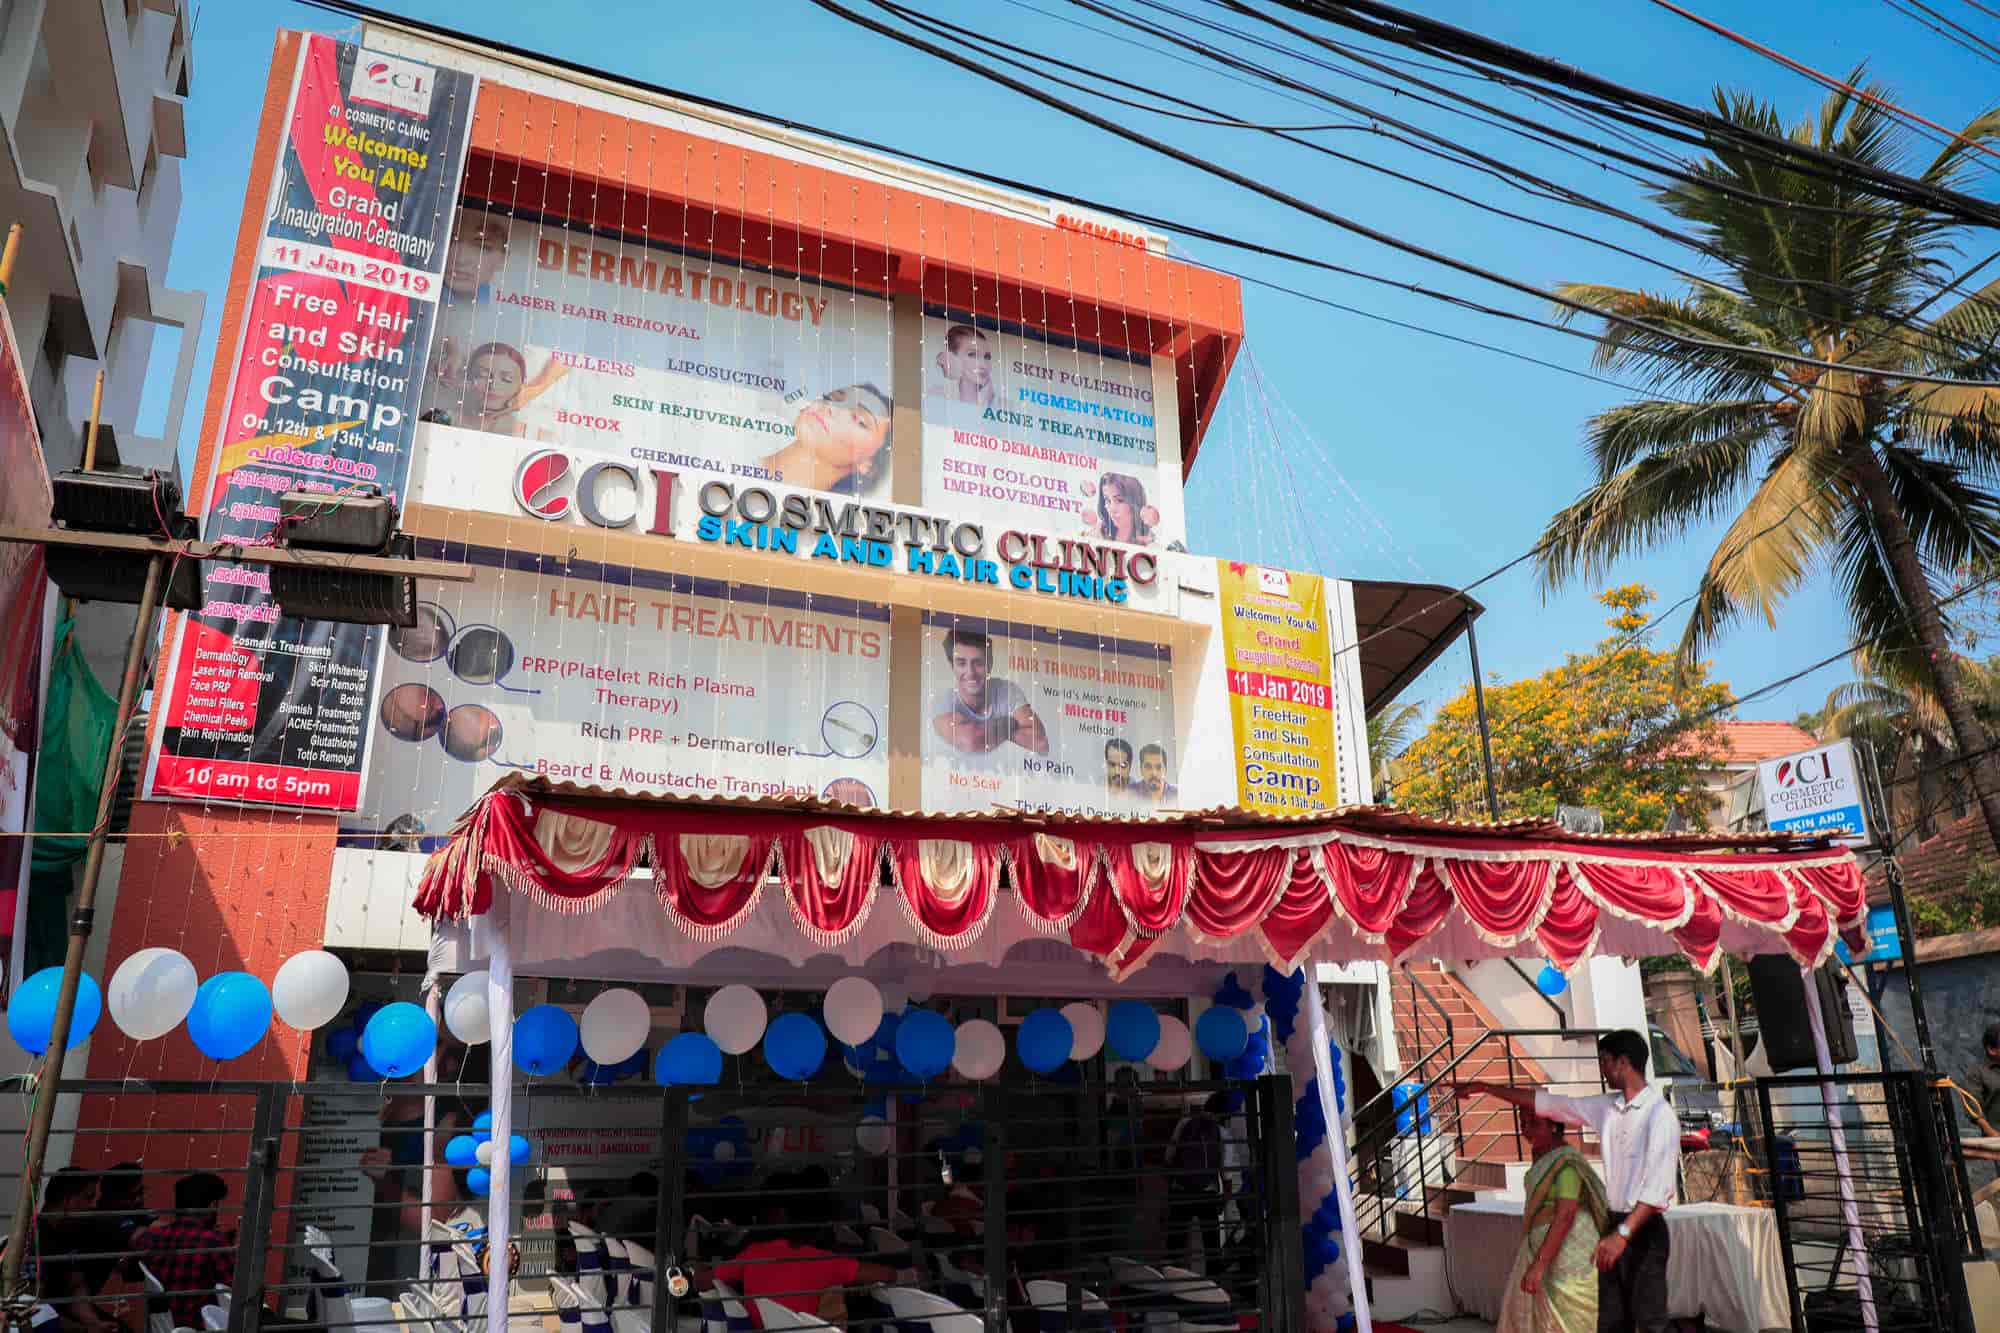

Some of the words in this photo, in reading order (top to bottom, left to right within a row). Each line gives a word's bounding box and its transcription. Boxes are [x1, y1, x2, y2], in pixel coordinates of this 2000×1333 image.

[345, 108, 396, 131] COSMETIC
[398, 121, 431, 141] CLINIC
[323, 124, 429, 169] Welcomes
[333, 155, 373, 184] You
[380, 167, 411, 193] All
[328, 187, 398, 221] Grand
[281, 201, 362, 240] Inaugration
[366, 218, 435, 264] Ceramany
[276, 246, 300, 264] 11
[310, 253, 355, 275] Jan
[364, 262, 430, 294] 2019
[538, 238, 829, 327] DERMATOLOGY
[273, 284, 338, 316] Free
[356, 302, 413, 333] Hair
[496, 289, 556, 313] LASER
[561, 303, 608, 323] HAIR
[612, 313, 701, 341] REMOVAL
[268, 322, 328, 348] and
[338, 331, 403, 365] Skin
[261, 347, 403, 392] Consultation
[551, 349, 636, 378] FILLERS
[666, 357, 786, 393] LIPOSUCTION
[1013, 361, 1054, 380] SKIN
[1060, 371, 1153, 402] POLISHING
[259, 375, 401, 430] Camp
[612, 393, 654, 412] SKIN
[660, 401, 796, 437] REJUVENATION
[1019, 388, 1154, 428] PIGMENTATION
[243, 413, 268, 432] On
[277, 417, 309, 438] 12th
[314, 425, 326, 440] &
[333, 428, 364, 449] 13th
[368, 435, 394, 454] Jan
[557, 411, 621, 432] BOTOX
[982, 407, 1034, 429] ACNE
[1039, 418, 1156, 453] TREATMENTS
[630, 447, 725, 473] CHEMICAL
[731, 463, 784, 482] PEELS
[953, 430, 999, 451] MICRO
[1002, 439, 1098, 470] DEMABRATION
[943, 458, 987, 478] SKIN
[993, 467, 1069, 493] COLOUR
[943, 477, 1083, 513] IMPROVEMENT
[576, 461, 680, 537] CI
[698, 480, 984, 557] COSMETIC
[997, 529, 1158, 586] CLINIC
[696, 514, 798, 553] SKIN
[811, 532, 894, 567] AND
[908, 546, 1000, 585] HAIR
[1010, 564, 1129, 604] CLINIC
[549, 589, 637, 627] HAIR
[651, 600, 882, 659] TREATMENTS
[1286, 615, 1304, 629] You
[231, 636, 277, 651] Cosmetic
[279, 640, 332, 657] Treatments
[1256, 630, 1302, 649] Grand
[192, 663, 218, 677] Laser
[218, 666, 237, 679] Hair
[237, 668, 275, 683] Removal
[195, 648, 250, 666] Dermatology
[308, 662, 328, 674] Skin
[329, 664, 369, 681] Whitening
[1008, 655, 1040, 673] HAIR
[1043, 659, 1166, 690] TRANSPLANTATION
[189, 679, 211, 692] Face
[212, 681, 232, 693] PRP
[310, 675, 330, 688] Scar
[331, 678, 367, 692] Removal
[522, 656, 642, 685] PRP(Platelet
[647, 671, 687, 690] Rich
[693, 676, 757, 698] Plasma
[1233, 671, 1249, 695] 11
[1259, 677, 1288, 700] Jan
[1292, 680, 1326, 707] 2019
[186, 694, 217, 708] Dermal
[218, 696, 245, 711] Fillers
[279, 702, 313, 715] Blemish
[317, 705, 362, 721] Treatments
[339, 693, 364, 706] Botox
[596, 687, 680, 715] Therapy)
[1065, 703, 1103, 721] Micro
[1105, 708, 1128, 724] FUE
[180, 726, 200, 739] Skin
[184, 710, 222, 724] Chemical
[224, 712, 248, 727] Peels
[310, 735, 358, 750] Glutathione
[580, 721, 621, 742] Rich
[628, 726, 663, 745] PRP
[670, 734, 681, 746] +
[686, 732, 796, 758] Dermaroller
[1254, 728, 1278, 741] and
[1282, 729, 1309, 746] Skin
[319, 750, 356, 764] Removal
[1022, 758, 1042, 772] No
[1046, 759, 1074, 776] Pain
[1243, 745, 1320, 769] Consultation
[1795, 751, 1833, 784] CI
[186, 766, 211, 785] 10
[216, 772, 249, 787] am
[256, 774, 279, 790] to
[284, 776, 331, 797] 5pm
[536, 758, 594, 780] Beard
[599, 764, 613, 781] &
[618, 768, 718, 792] Moustache
[723, 775, 815, 797] Transplant
[948, 771, 968, 786] No
[972, 774, 1003, 791] Scar
[1245, 763, 1321, 796] Camp
[1770, 778, 1846, 805] COSMETIC
[1785, 793, 1834, 813] CLINIC
[1819, 811, 1846, 826] AND
